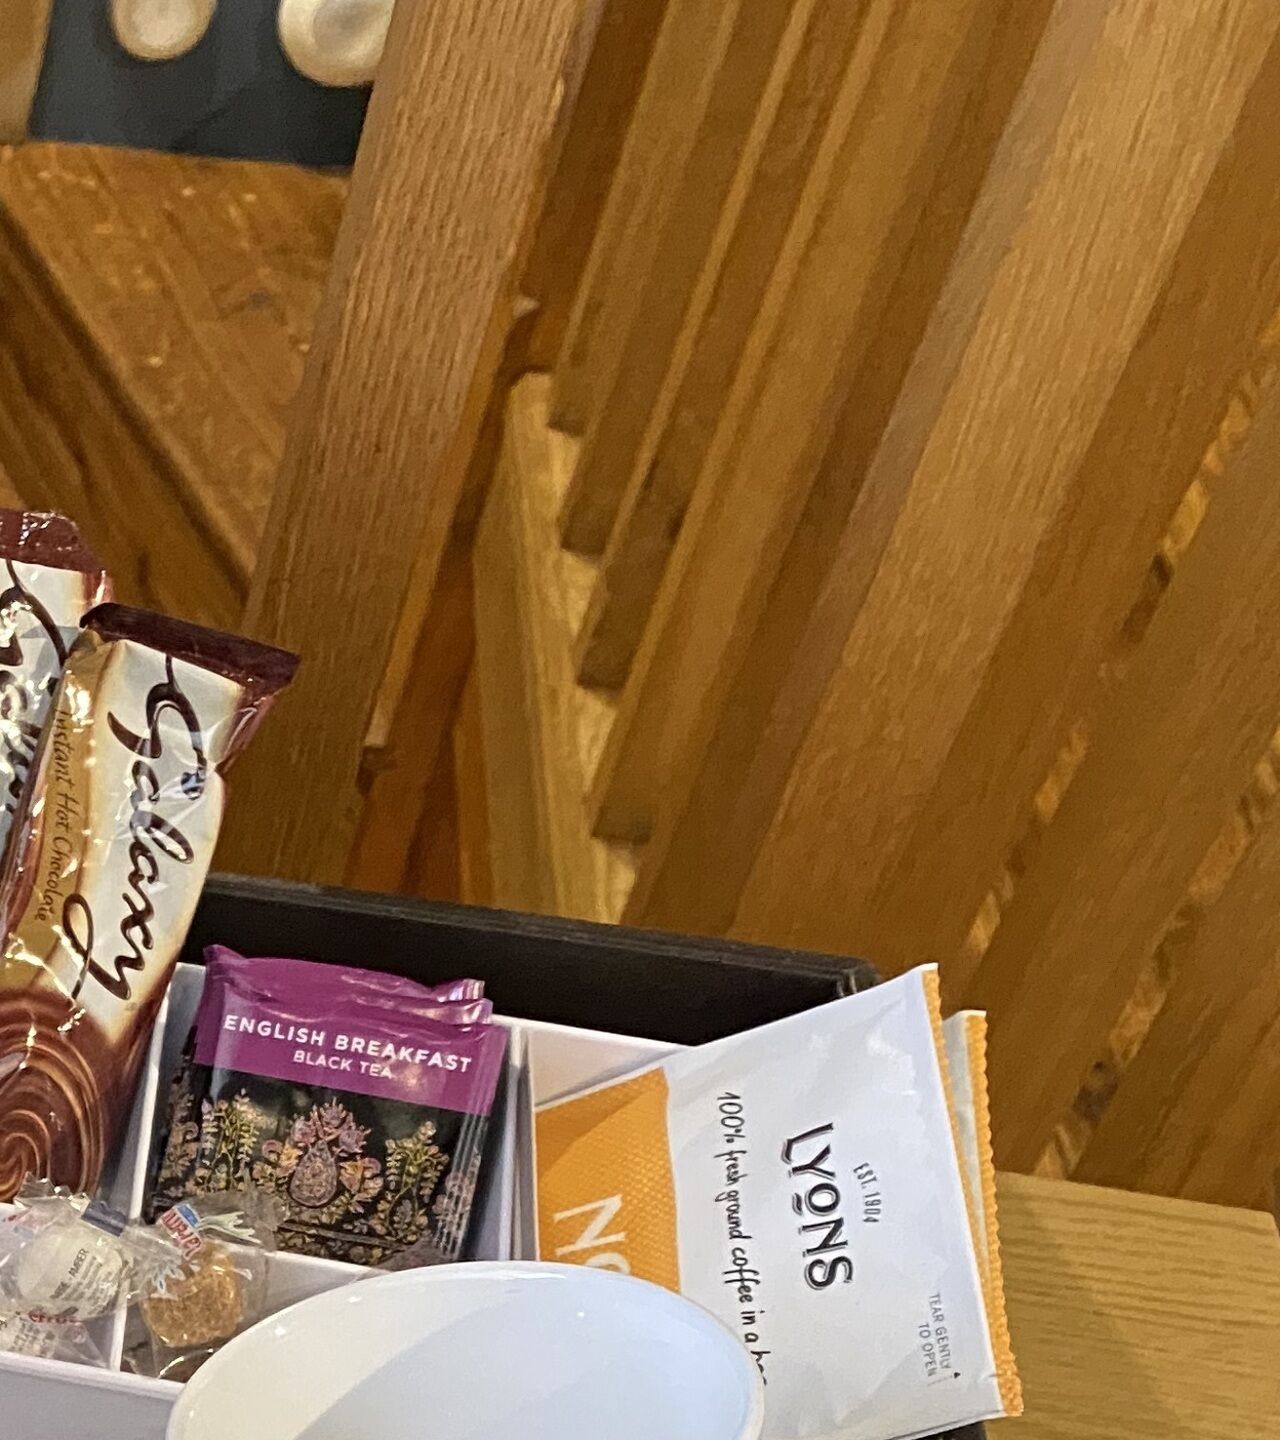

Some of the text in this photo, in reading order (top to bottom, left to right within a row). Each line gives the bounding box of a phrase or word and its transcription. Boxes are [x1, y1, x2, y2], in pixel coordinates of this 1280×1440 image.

[35, 708, 81, 921] Instant Hot Chocolate
[62, 655, 207, 1001] Galaxy
[223, 1013, 472, 1074] ENGLISH BREAKFAST
[293, 1049, 394, 1080] BLACK TEA
[717, 1090, 747, 1145] 100%
[713, 1149, 749, 1186] fresh
[853, 1162, 882, 1224] EST. 1904
[715, 1190, 752, 1240] ground
[781, 1121, 854, 1291] LYONS
[722, 1247, 760, 1304] coffee
[741, 1309, 766, 1326] in
[744, 1332, 759, 1343] a
[929, 1292, 952, 1370] TEAR GENTLY
[918, 1322, 938, 1377] TO OPEN
